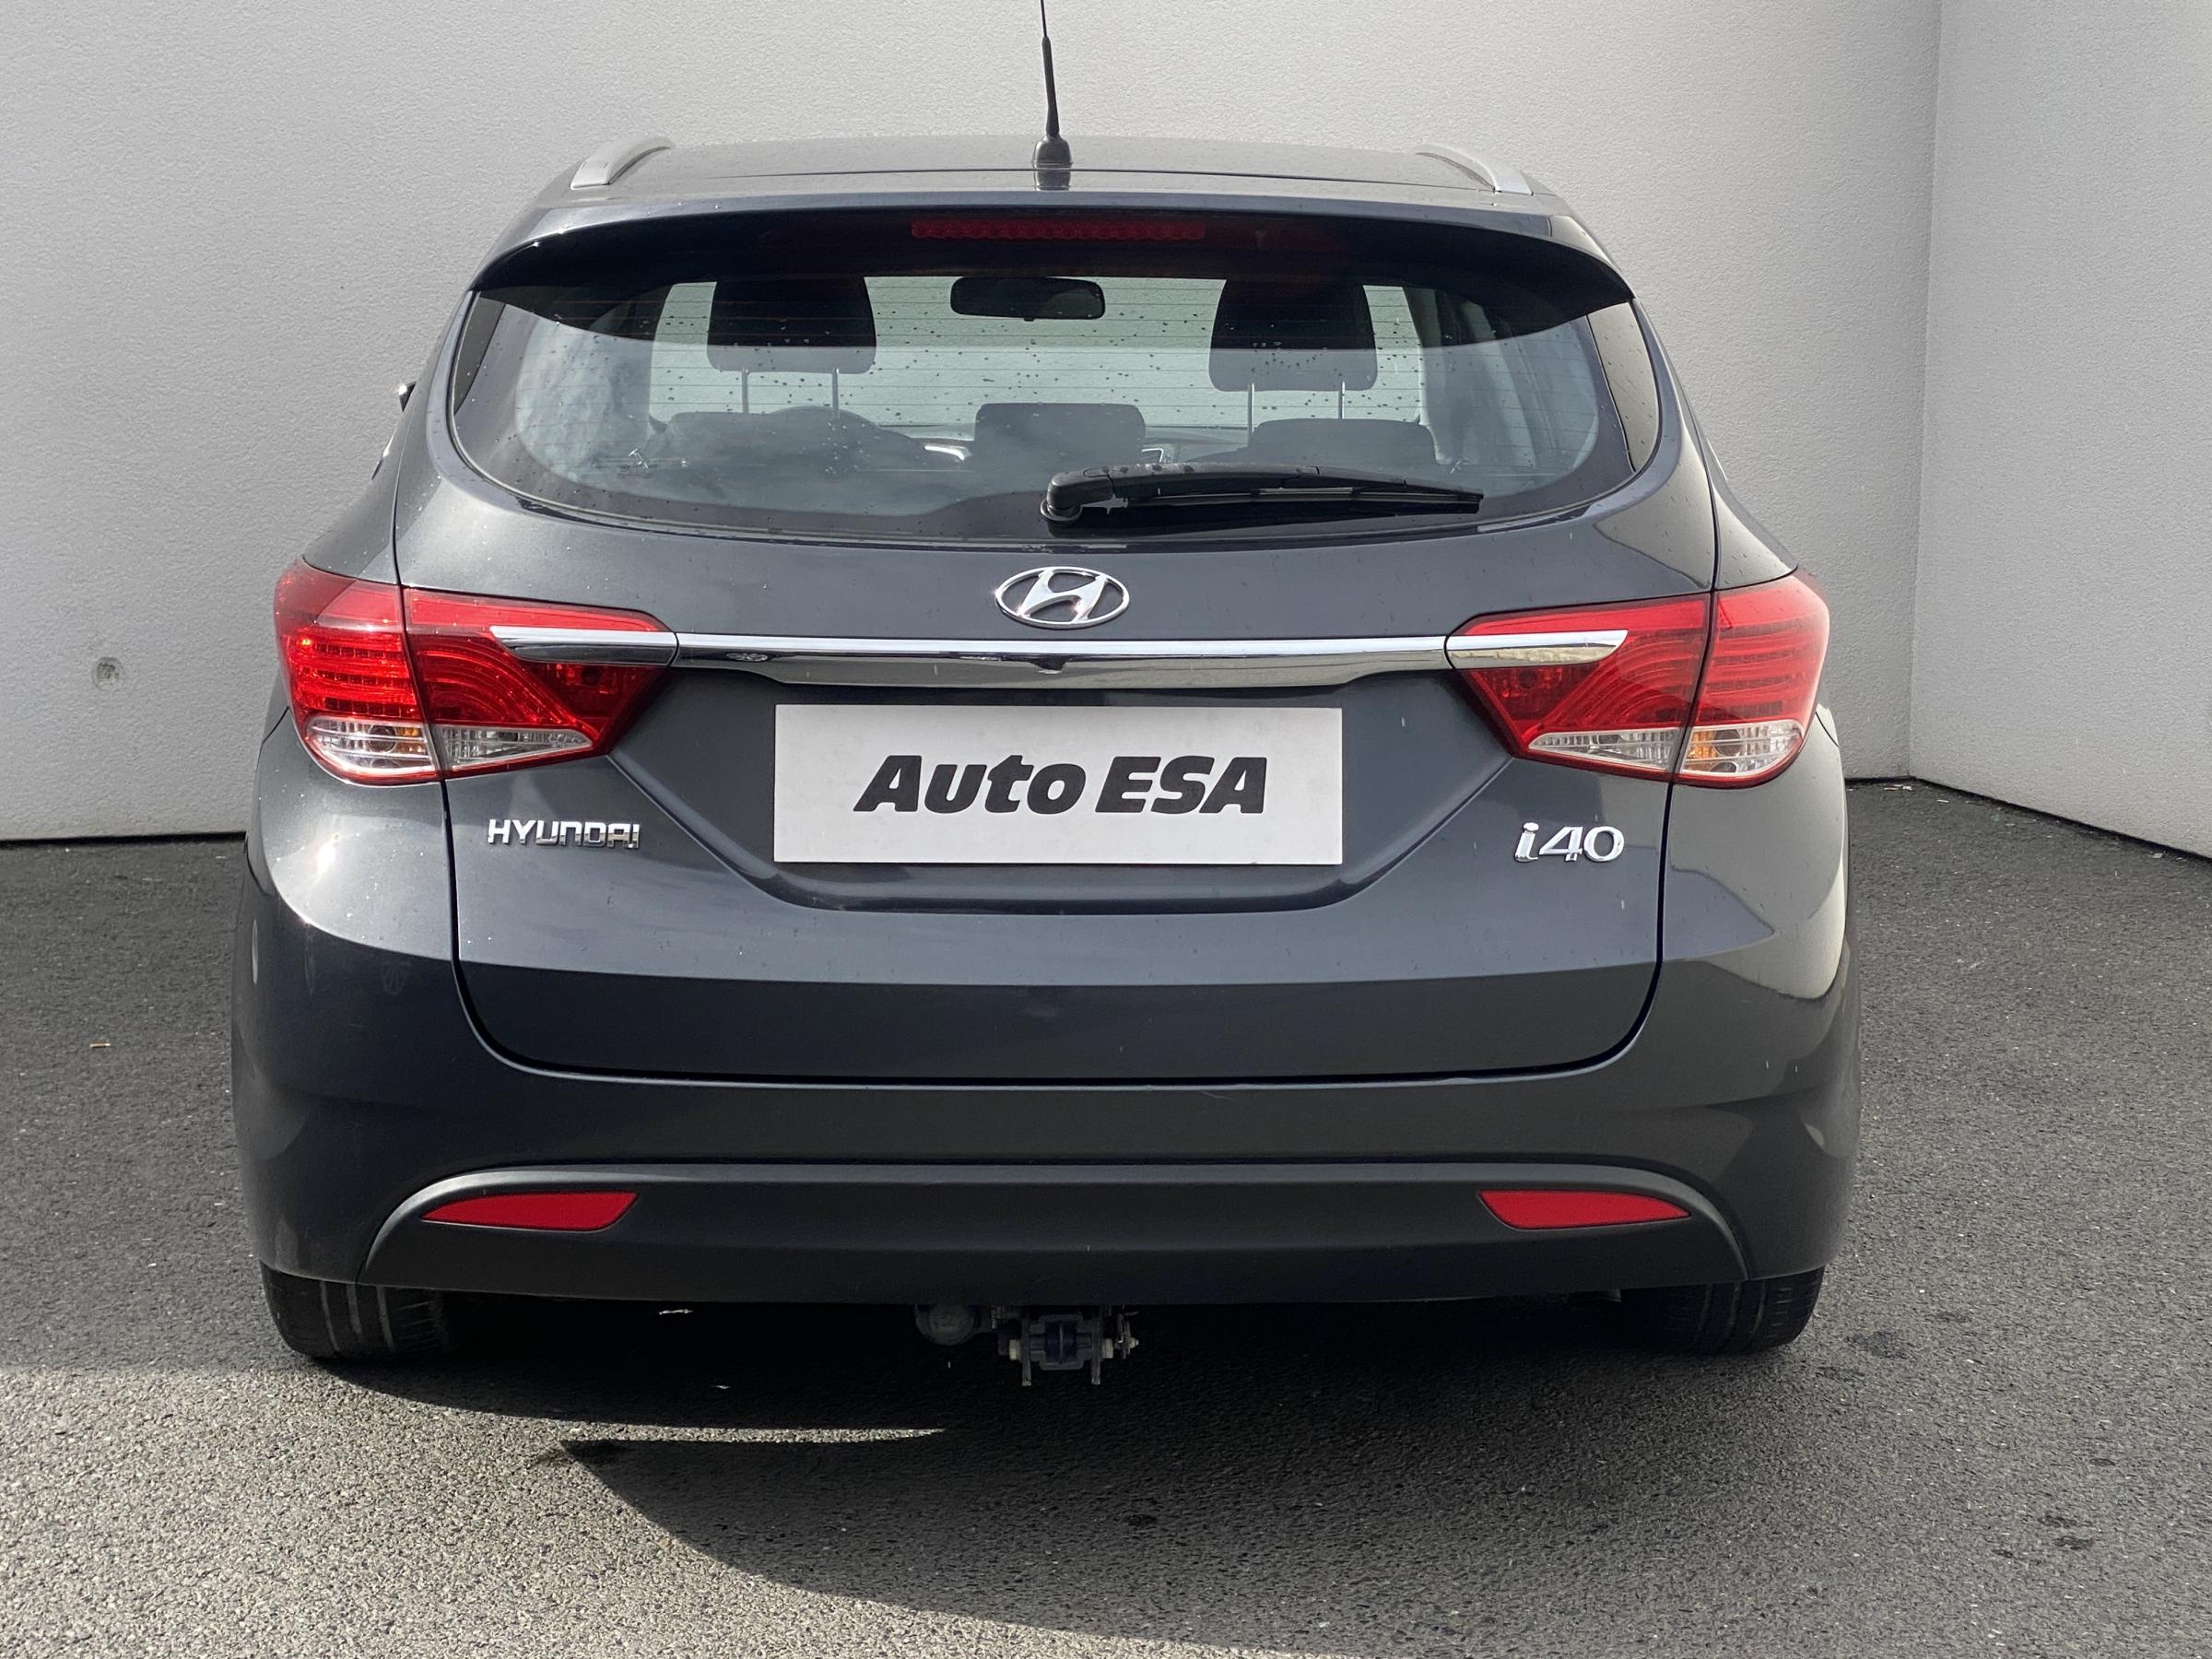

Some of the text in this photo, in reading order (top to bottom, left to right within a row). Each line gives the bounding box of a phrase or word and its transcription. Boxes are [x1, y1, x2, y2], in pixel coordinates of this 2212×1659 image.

[853, 754, 1267, 815] Auto ESA
[487, 818, 641, 849] HYUNDAI
[1514, 821, 1625, 863] i40
